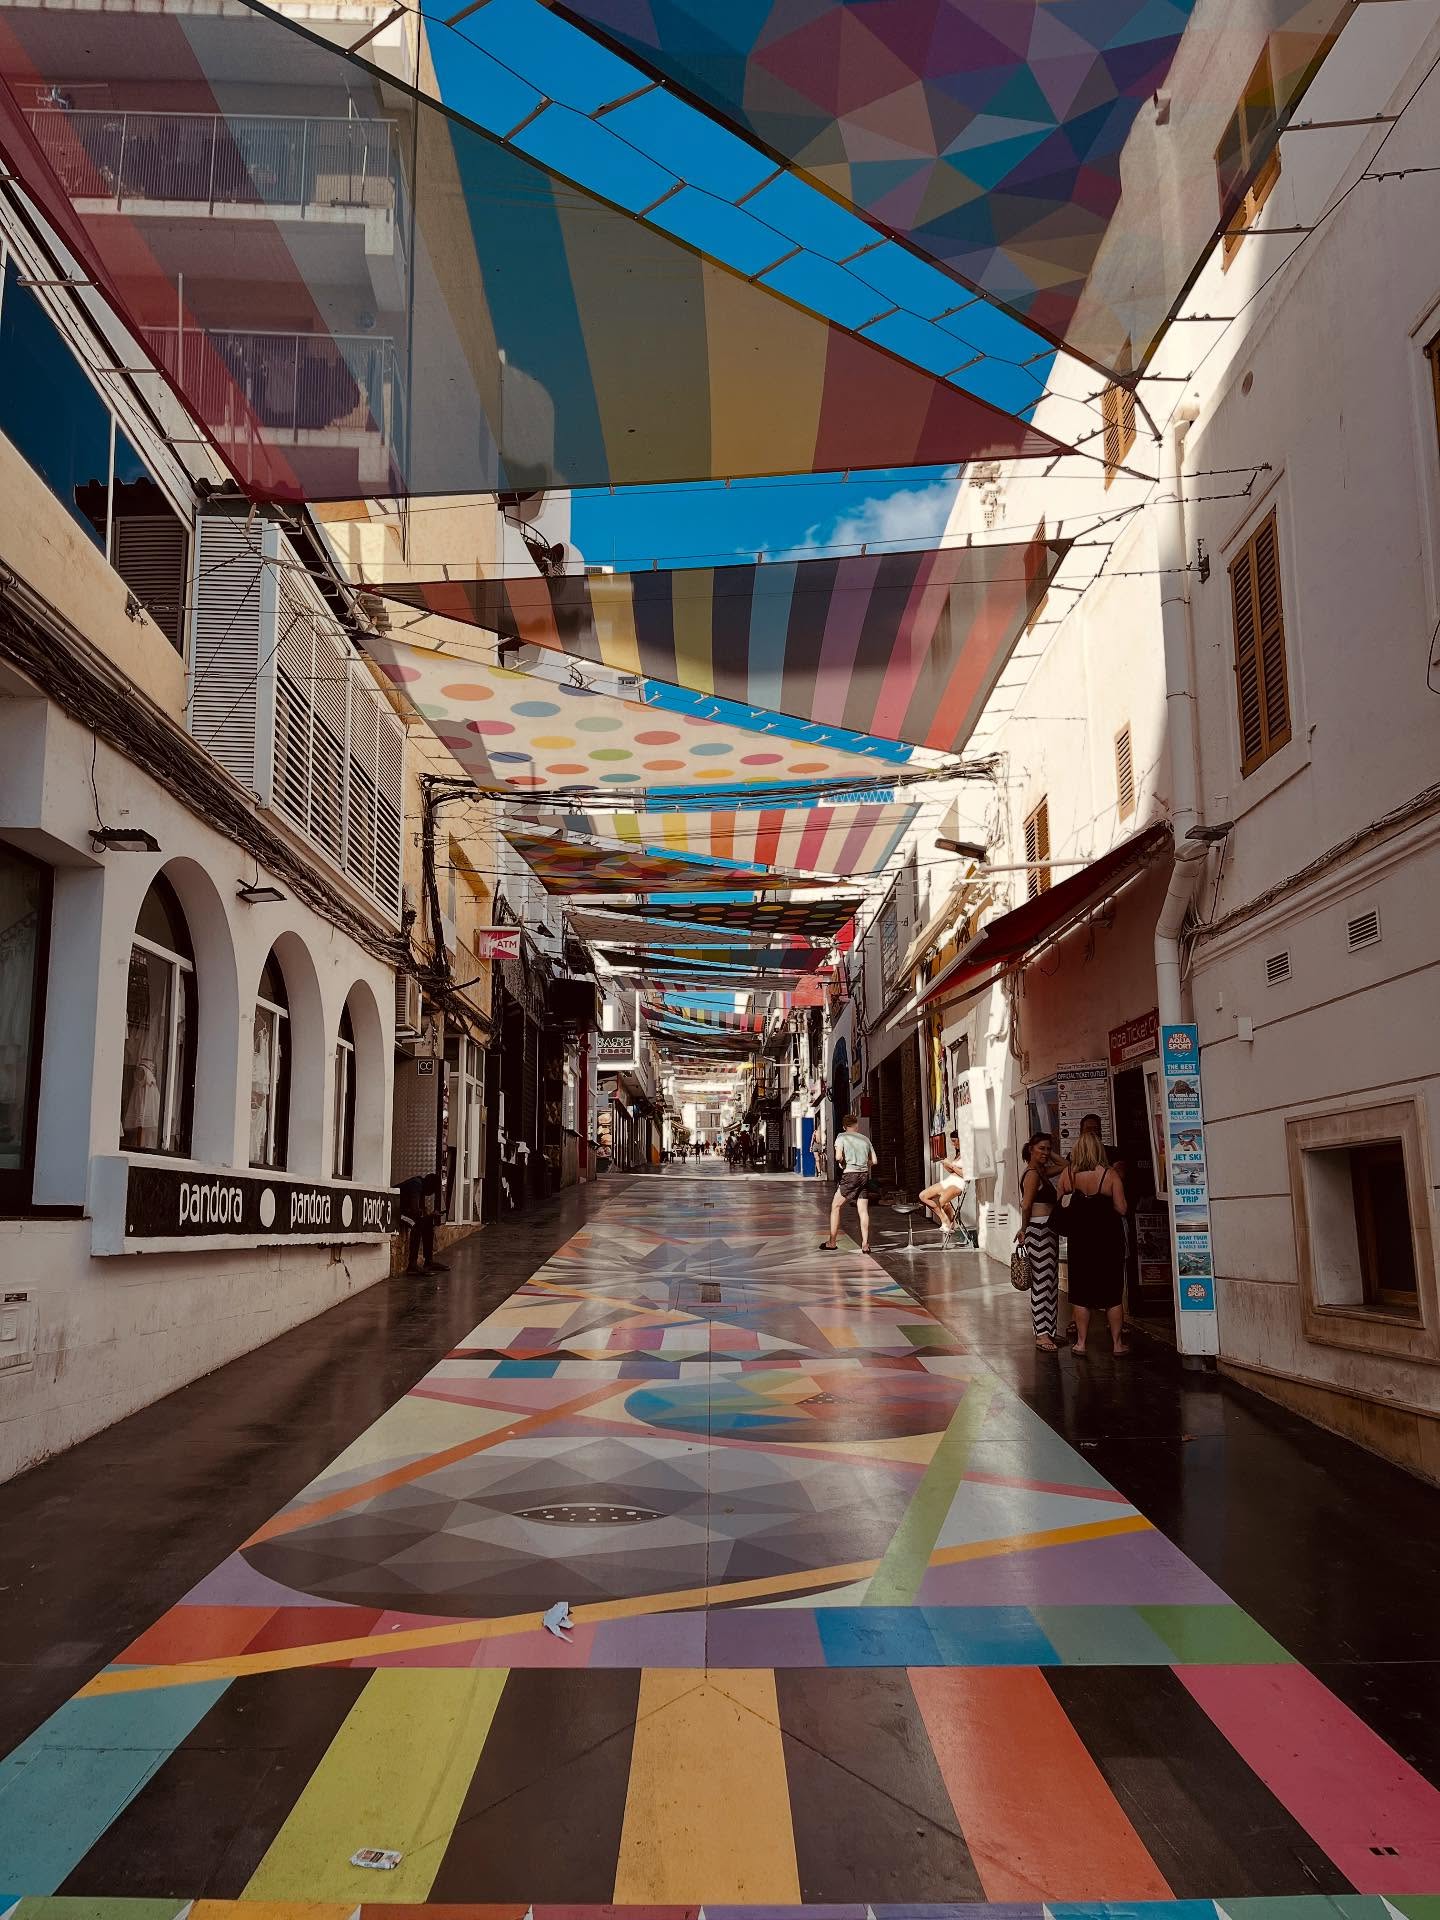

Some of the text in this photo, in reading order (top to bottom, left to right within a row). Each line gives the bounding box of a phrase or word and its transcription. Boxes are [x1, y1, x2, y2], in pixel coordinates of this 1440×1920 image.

[497, 940, 517, 949] ATM
[1188, 1153, 1202, 1161] SKI
[179, 1180, 243, 1226] pandora
[290, 1189, 331, 1229] pandora
